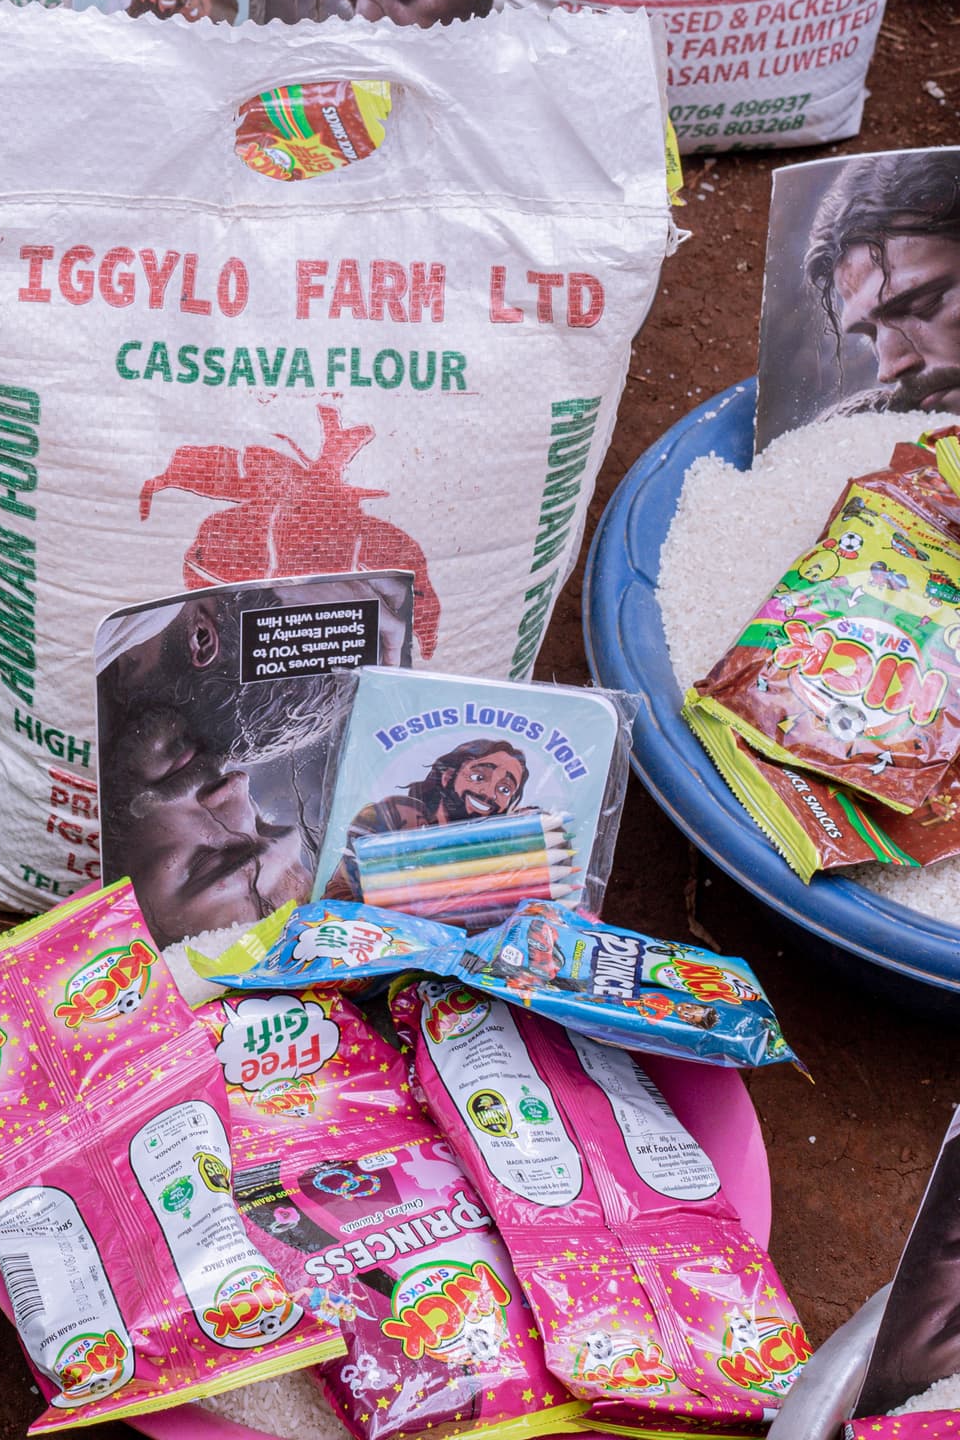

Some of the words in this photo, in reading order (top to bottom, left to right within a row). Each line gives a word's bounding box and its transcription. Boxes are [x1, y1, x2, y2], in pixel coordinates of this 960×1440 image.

[682, 30, 768, 59] FARM
[775, 5, 878, 49] LIMITED
[729, 9, 749, 30] &
[758, 36, 859, 78] LUWERO
[668, 102, 726, 121] 0764
[732, 92, 812, 120] 496937
[722, 113, 806, 137] 803268
[19, 245, 248, 316] IGGYLO
[297, 259, 445, 322] FARM
[490, 266, 604, 327] LTD
[116, 342, 314, 387] CASSAVA
[327, 347, 466, 390] FLOUR
[533, 398, 603, 578] HUMAN
[257, 616, 277, 626] Him
[281, 612, 310, 624] with
[314, 609, 362, 620] Heaven
[325, 624, 364, 636] Spend
[259, 632, 269, 642] in
[274, 626, 321, 641] Eternity
[302, 642, 339, 652] wants
[341, 639, 365, 649] and
[837, 621, 911, 654] SNACKS
[253, 647, 265, 657] to
[269, 643, 299, 657] YOU
[289, 656, 323, 670] Loves
[326, 654, 362, 669] Jesus
[256, 660, 287, 674] YOU
[774, 619, 948, 726] KICK
[13, 704, 91, 765] HIGH
[375, 706, 458, 749] Jesus
[465, 704, 543, 740] Loves
[544, 731, 587, 780] You
[804, 795, 842, 839] SNACKS
[350, 925, 384, 965] Free
[73, 955, 115, 987] SNACKS
[581, 930, 640, 998] PRINCE
[54, 939, 158, 1027] KICK
[672, 958, 741, 1004] KICK
[243, 1007, 313, 1055] Gift
[459, 1004, 487, 1033] SNACKS
[240, 1035, 324, 1084] Free
[636, 1146, 652, 1155] SRK
[654, 1143, 677, 1153] Foods
[386, 1199, 423, 1216] Chicken
[305, 1191, 492, 1285] PRINCESS
[220, 1272, 259, 1297] SNACKS
[399, 1269, 449, 1303] SNACKS
[381, 1261, 511, 1360] KICK
[718, 1323, 813, 1389] KICK
